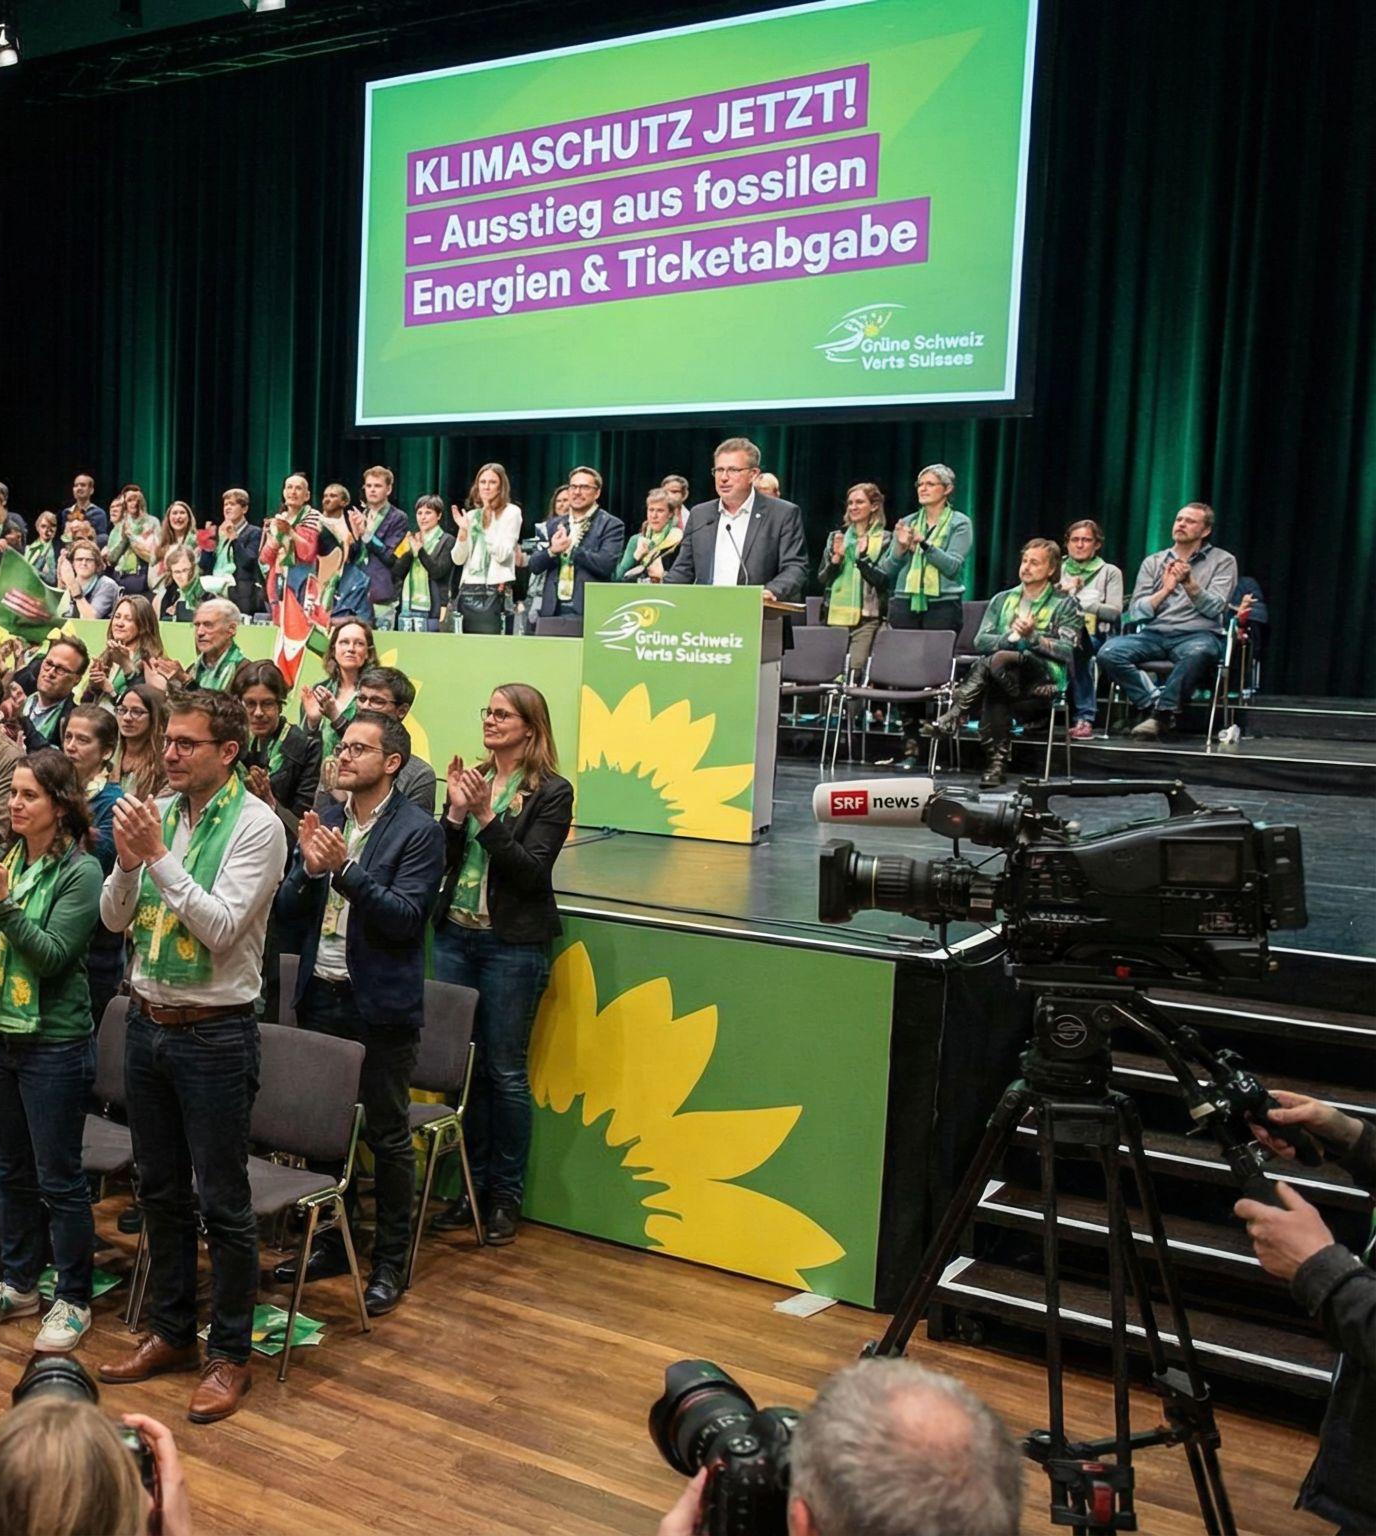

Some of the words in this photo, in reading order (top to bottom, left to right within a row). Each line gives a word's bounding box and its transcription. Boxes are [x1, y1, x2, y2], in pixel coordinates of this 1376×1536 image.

[414, 108, 693, 196] KLIMASCHUTZ
[703, 77, 857, 144] JETZT!
[440, 196, 603, 252] Ausstieg
[612, 187, 683, 225] aus
[693, 154, 867, 213] fossilen
[413, 263, 571, 316] Energien
[580, 254, 611, 294] &
[618, 213, 918, 288] Ticketabgabe
[861, 337, 910, 353] Grüne
[914, 331, 985, 350] Schweiz
[862, 355, 905, 370] Verts
[909, 352, 974, 368] Suisses
[635, 630, 678, 645] Grüne
[681, 631, 744, 648] Schweiz
[635, 645, 673, 661] Verts
[675, 648, 732, 664] Suisses
[833, 797, 864, 810] SRF
[873, 797, 920, 808] news
